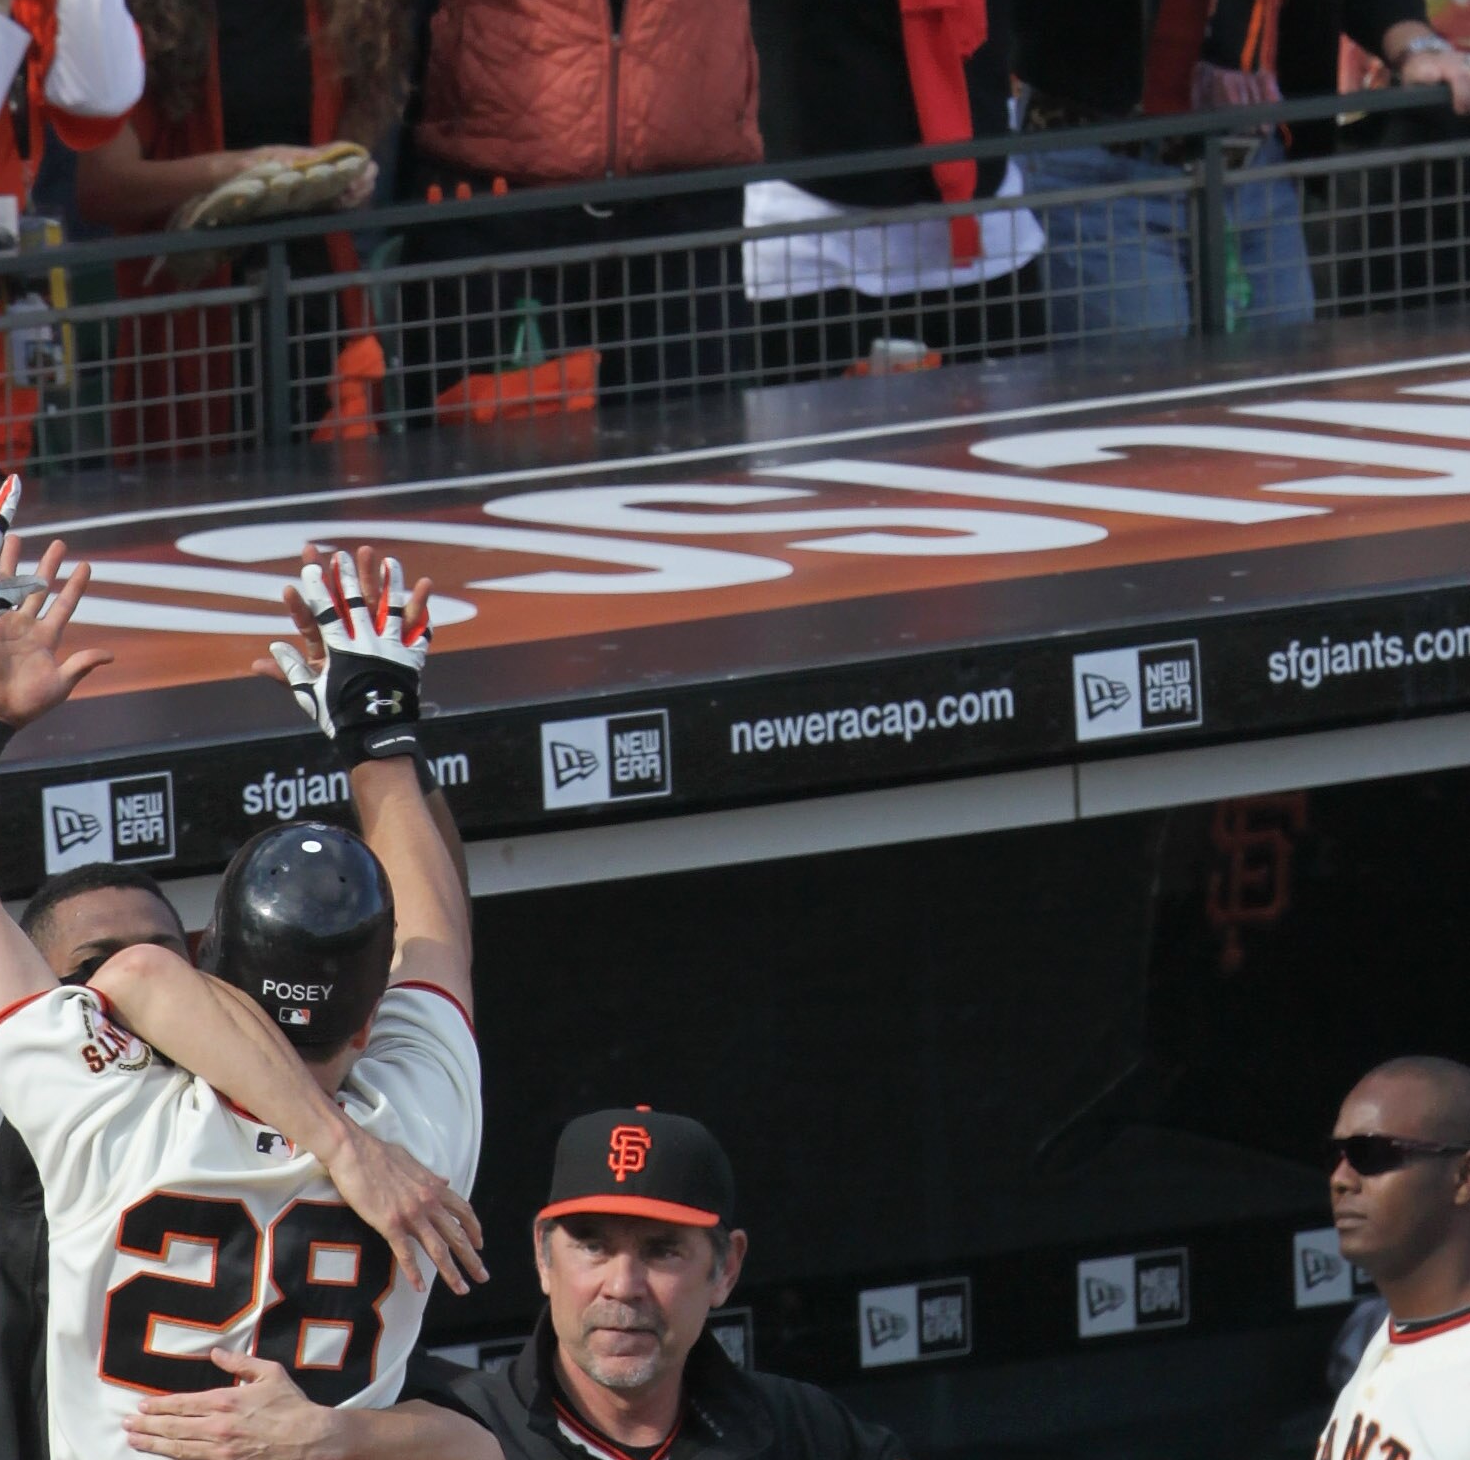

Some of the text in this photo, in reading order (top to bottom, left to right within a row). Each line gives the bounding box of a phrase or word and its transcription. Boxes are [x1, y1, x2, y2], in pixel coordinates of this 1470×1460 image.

[1144, 660, 1191, 686] NEW
[1146, 685, 1192, 713] ERA
[731, 687, 1015, 754] neweracap.com
[615, 729, 659, 755] NEW
[615, 754, 660, 781] ERA
[116, 792, 164, 819] NEW
[117, 818, 165, 846] ERA
[263, 979, 334, 1001] POSEY
[608, 1125, 653, 1183] SF
[98, 1189, 397, 1409] 28
